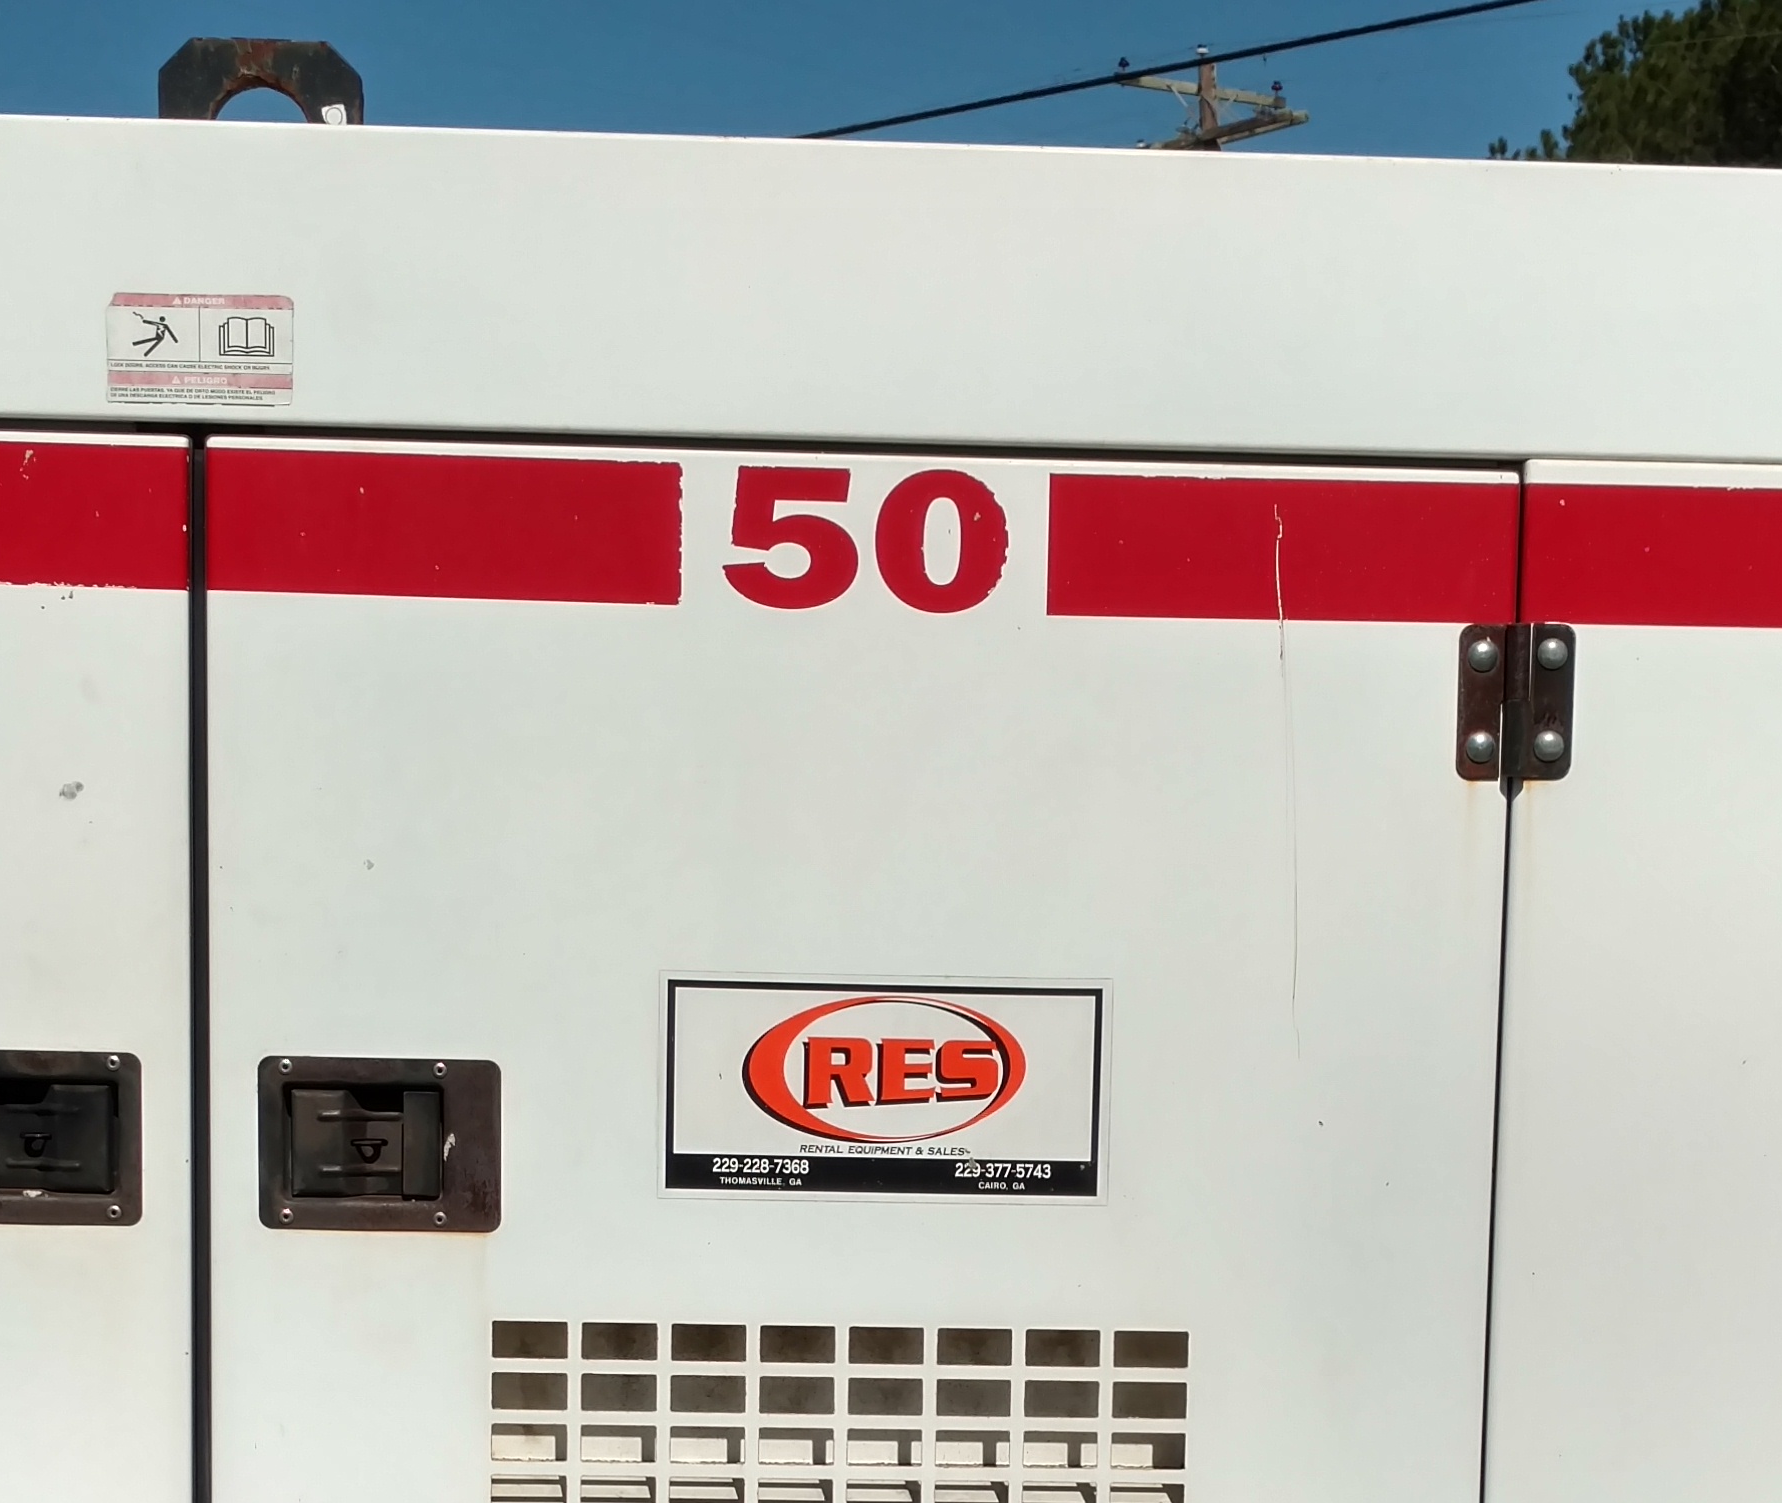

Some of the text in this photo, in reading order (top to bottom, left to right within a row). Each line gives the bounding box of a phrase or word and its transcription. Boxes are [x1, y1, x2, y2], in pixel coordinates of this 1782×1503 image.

[183, 296, 226, 305] DANGER
[184, 375, 228, 385] PELIGRO
[721, 464, 1010, 614] 50
[802, 1036, 999, 1109] RES
[799, 1144, 966, 1156] RENTAL EQUIPMENT & SALES
[712, 1157, 810, 1175] 229-228-7368
[954, 1162, 1052, 1179] 229-377-5743
[788, 1177, 803, 1187] GA
[1012, 1182, 1026, 1191] GA
